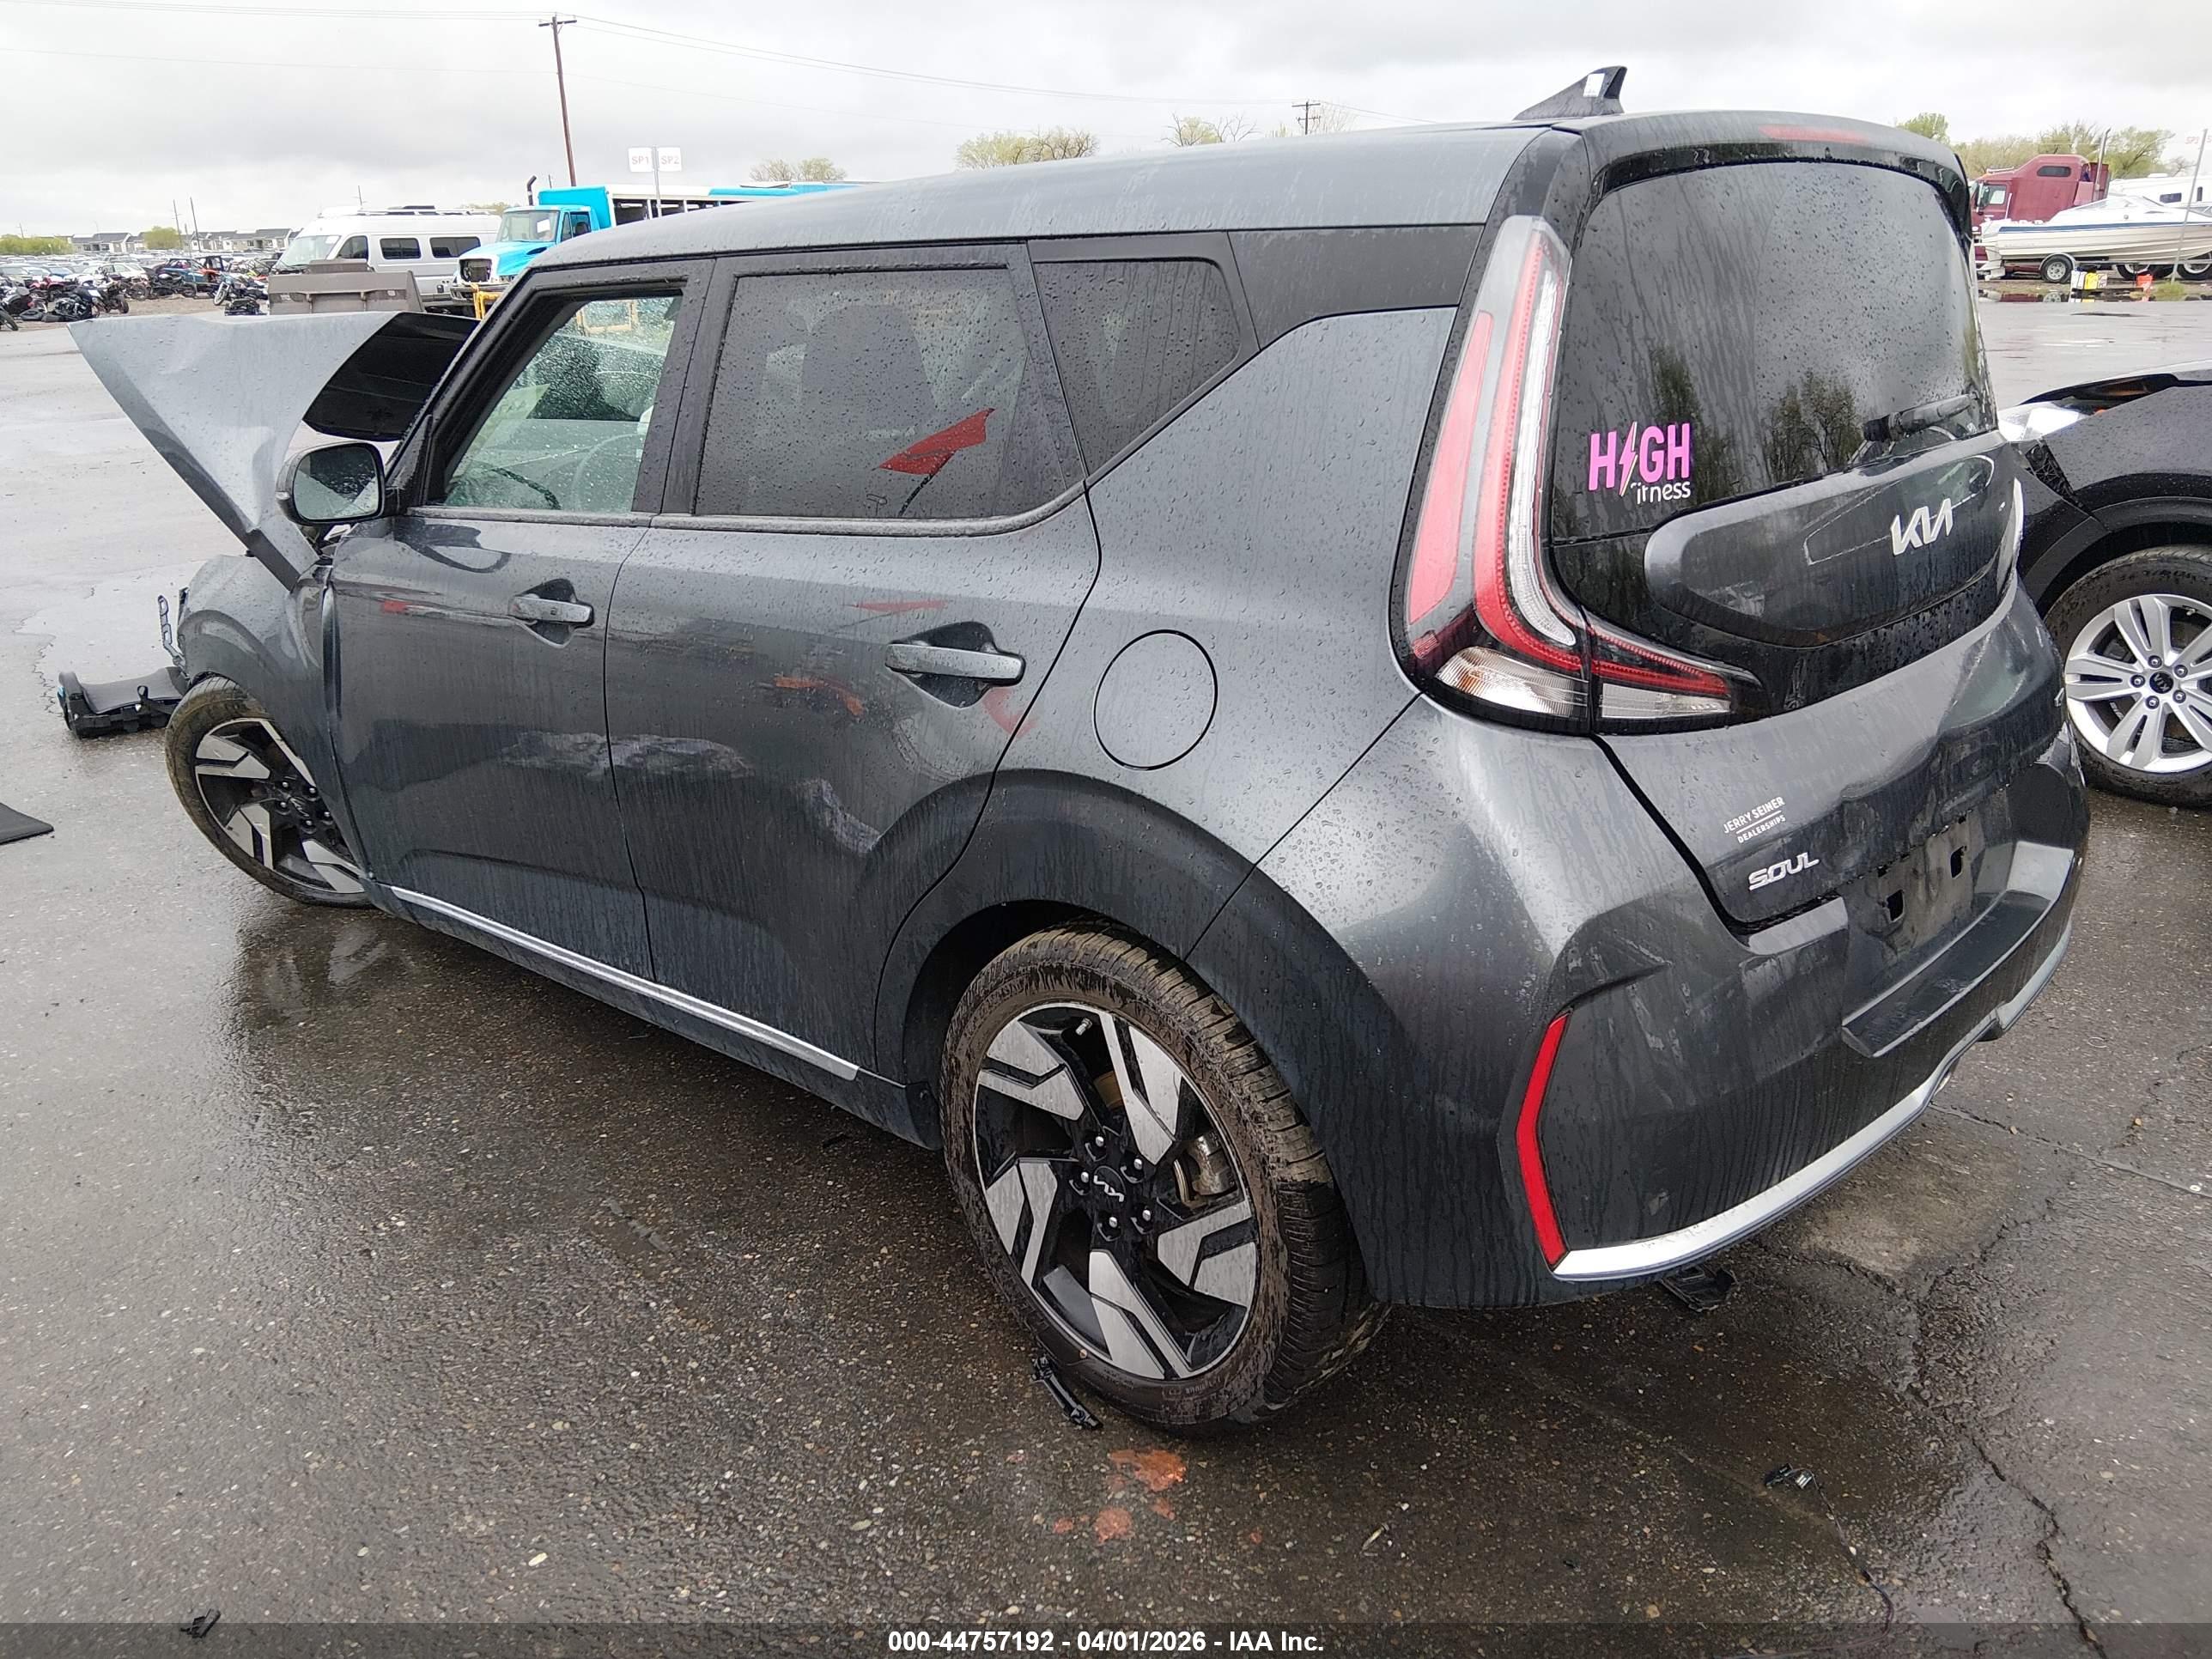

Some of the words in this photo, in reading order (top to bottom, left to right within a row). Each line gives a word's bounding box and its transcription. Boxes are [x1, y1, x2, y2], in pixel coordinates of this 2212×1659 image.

[631, 155, 650, 165] SP1
[660, 155, 680, 165] SP2
[1587, 421, 1691, 497] HIGH
[1890, 497, 1954, 556] KIA
[2154, 673, 2170, 691] KIA
[1723, 811, 1753, 834] JERRY
[1752, 796, 1785, 819] SEINER
[1737, 815, 1786, 843] DEALERSHIPS
[1748, 852, 1820, 891] SOUL
